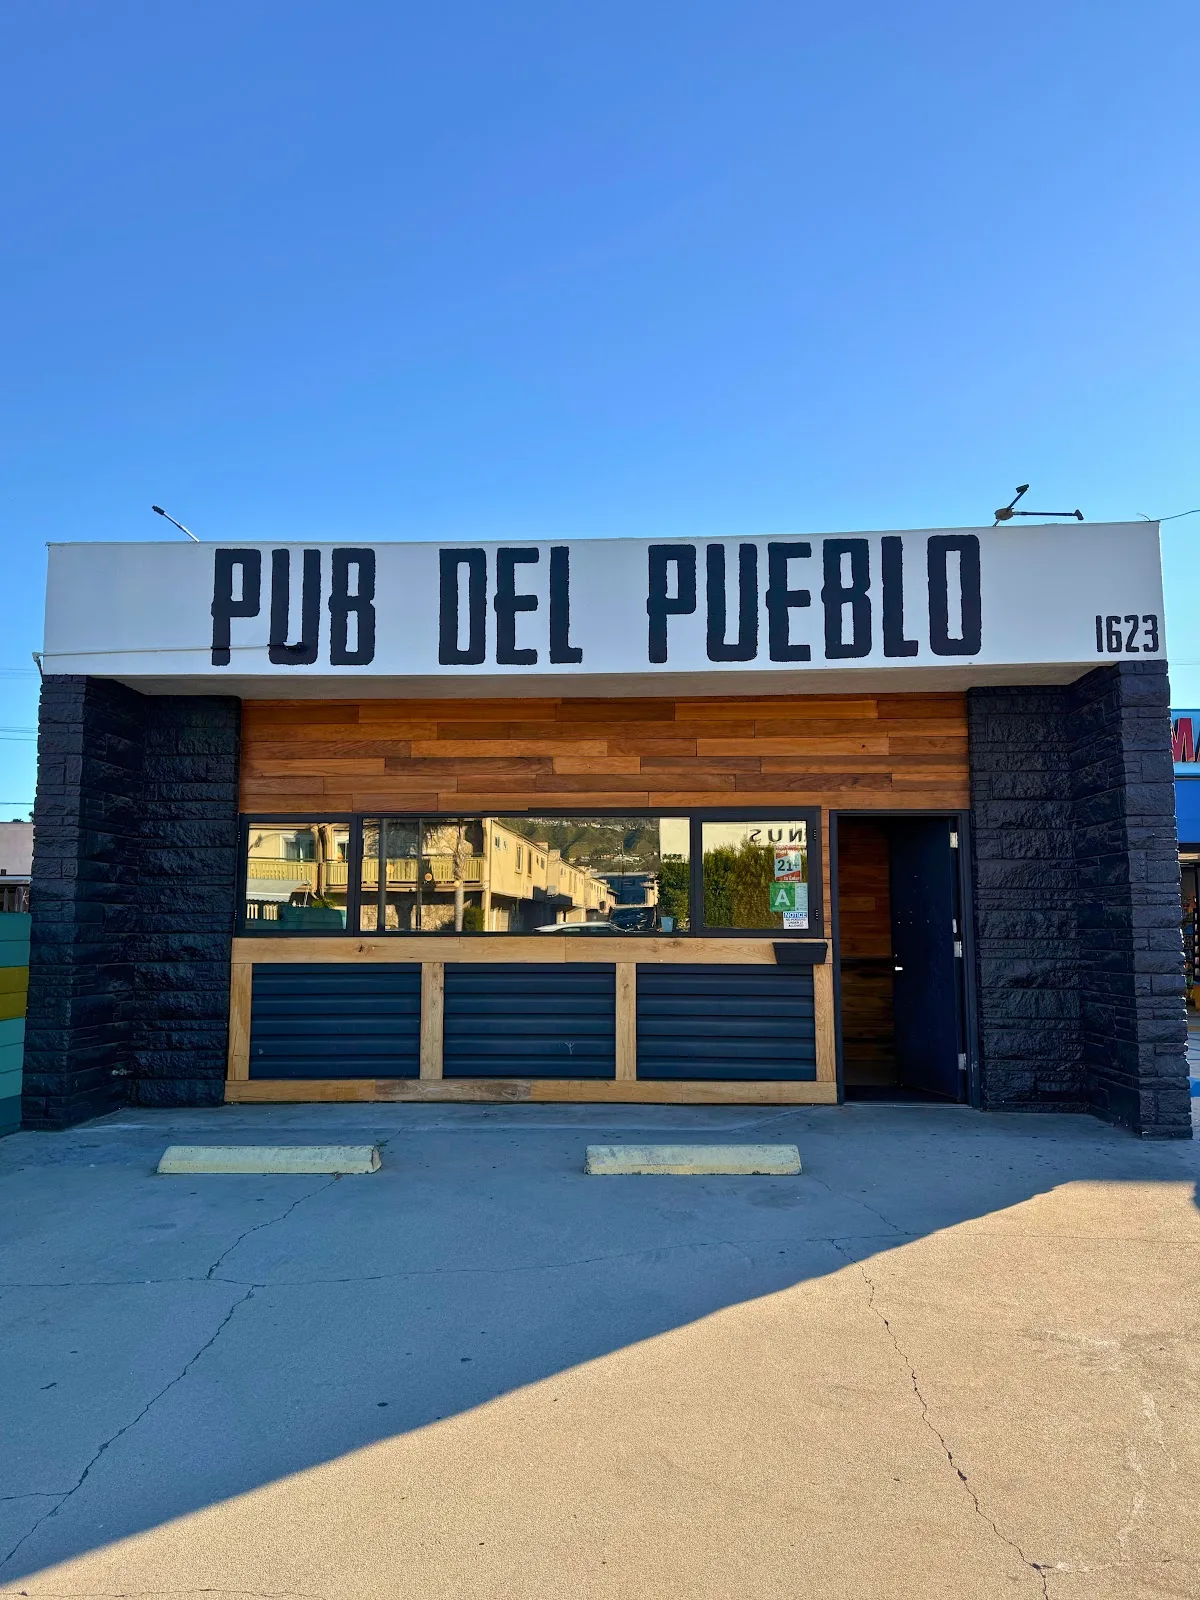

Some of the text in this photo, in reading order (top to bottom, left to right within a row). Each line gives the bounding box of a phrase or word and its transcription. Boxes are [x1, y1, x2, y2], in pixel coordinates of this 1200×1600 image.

[211, 534, 982, 666] PUB DEL PUEBLO
[1095, 614, 1160, 653] 1623
[1171, 717, 1200, 762] M
[774, 888, 791, 906] A
